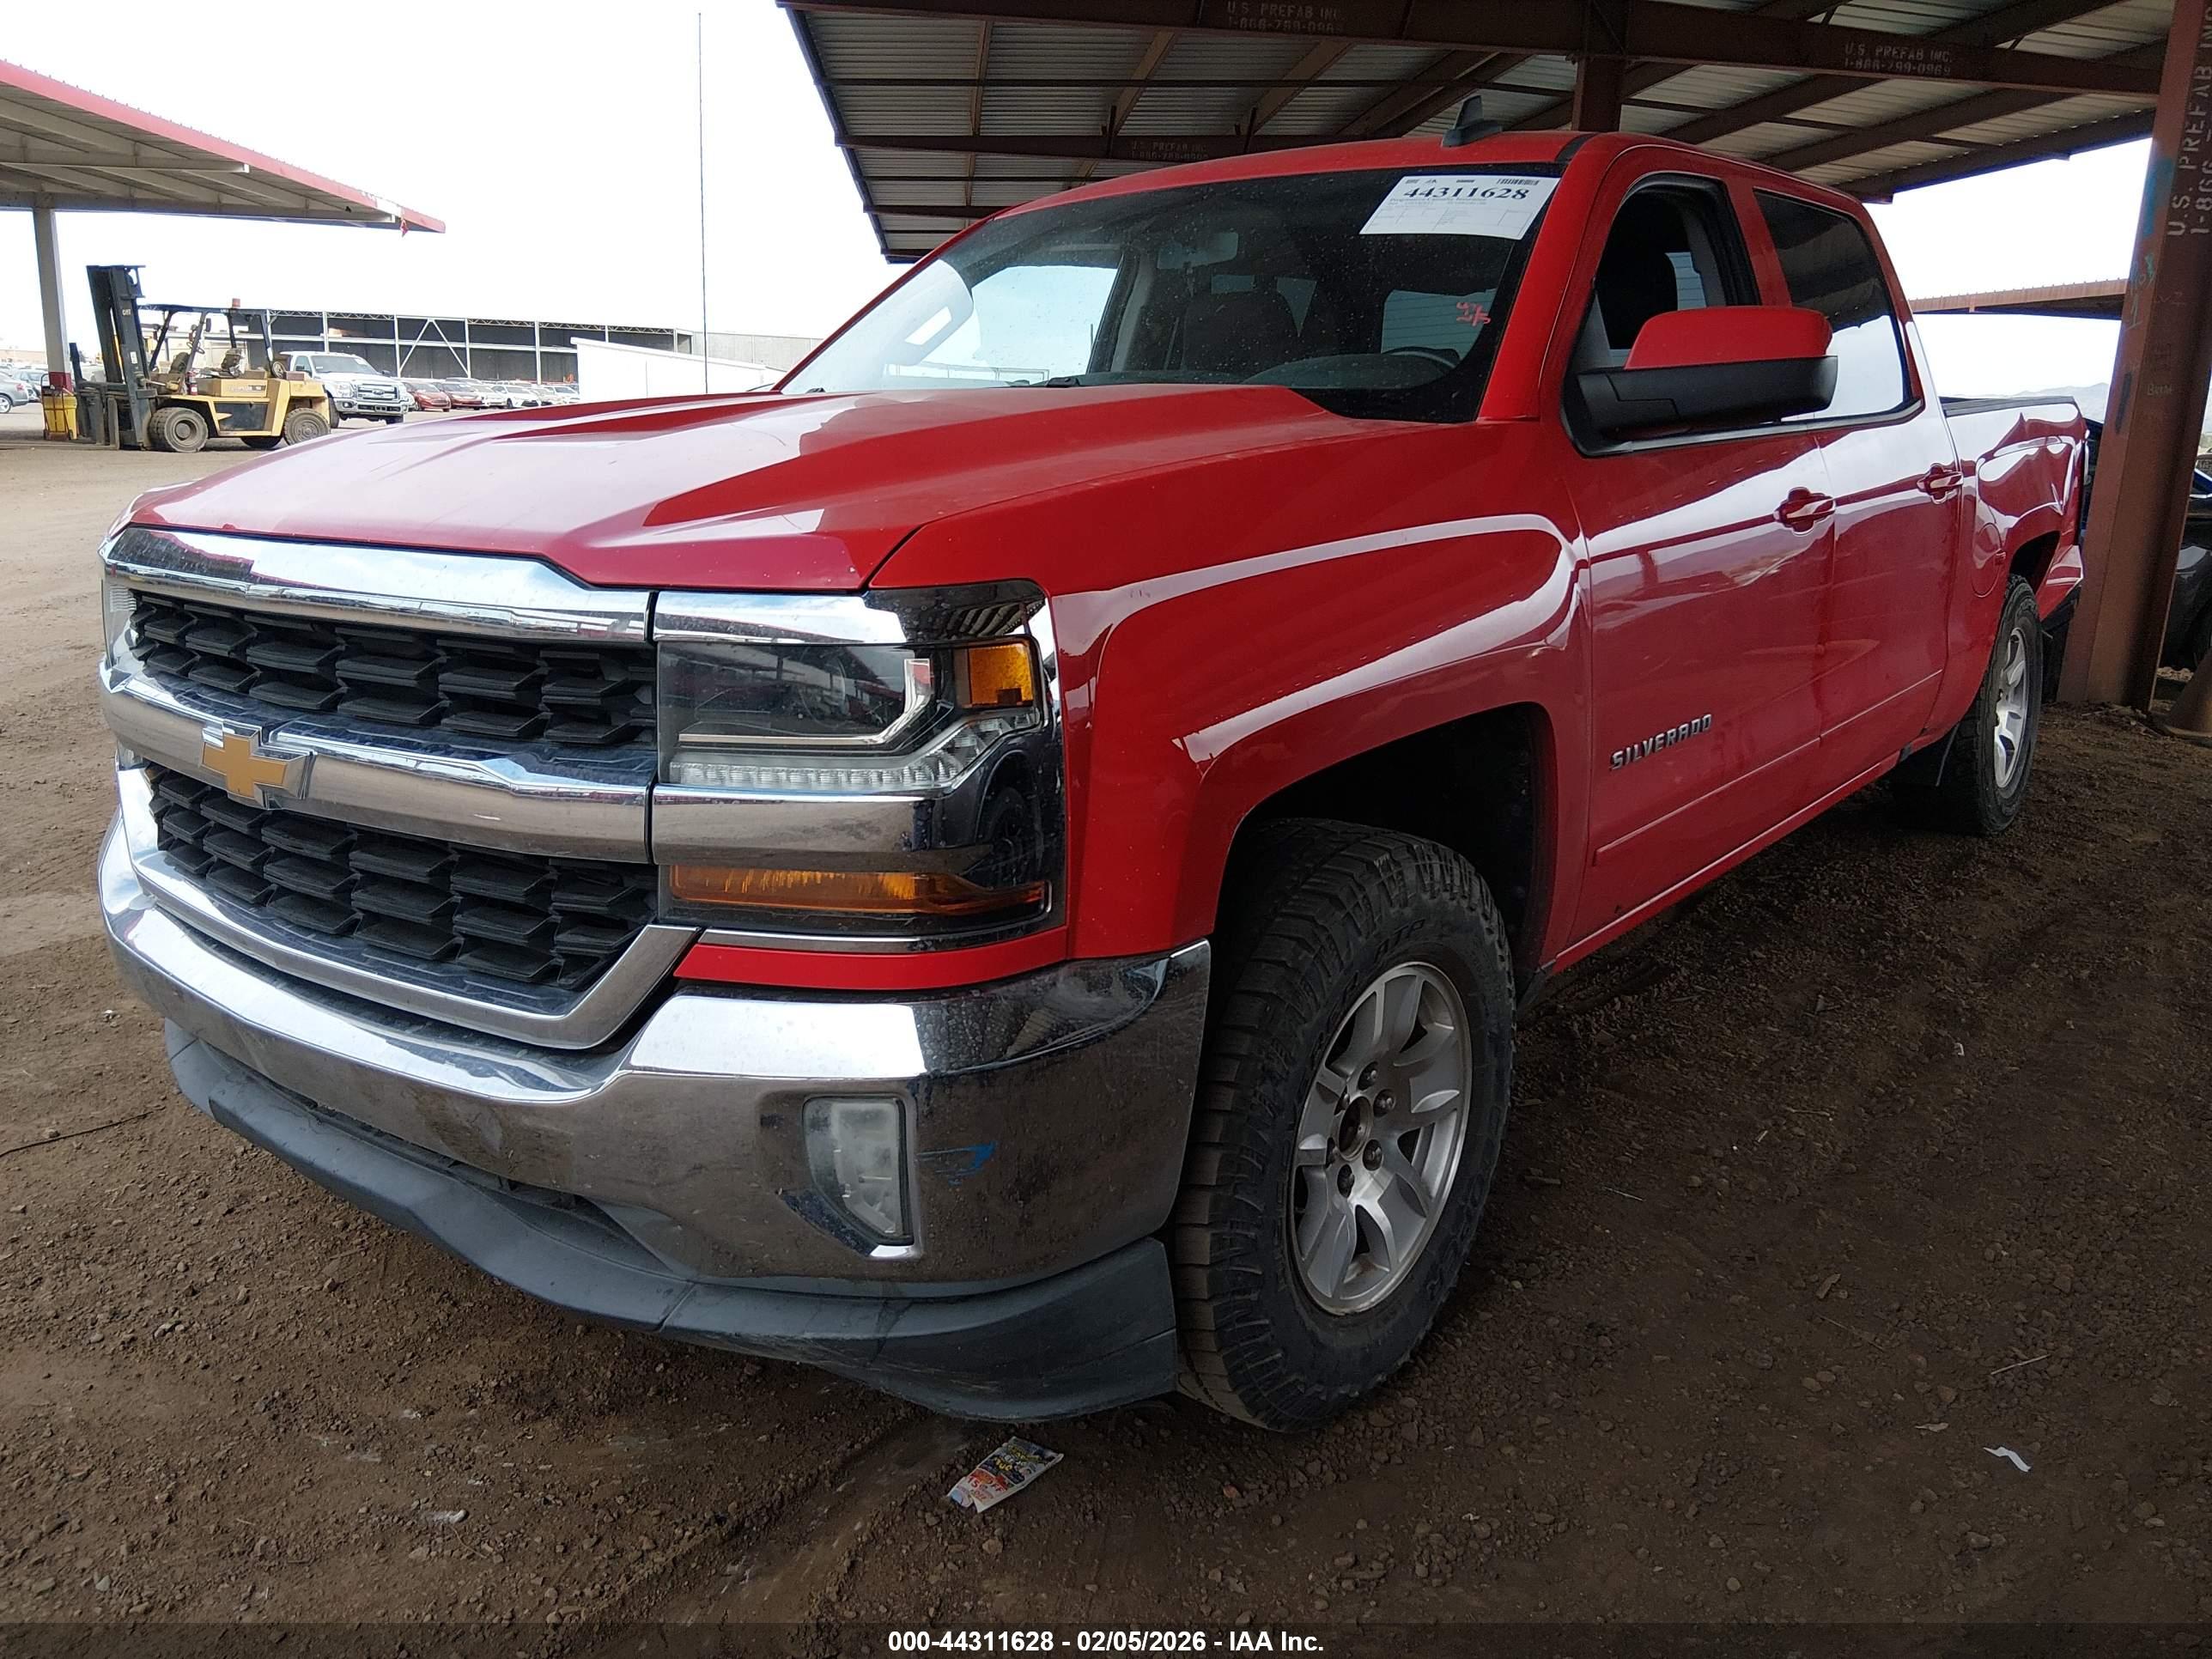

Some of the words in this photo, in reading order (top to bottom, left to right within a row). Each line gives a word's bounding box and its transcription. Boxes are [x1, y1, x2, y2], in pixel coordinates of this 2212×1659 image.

[1875, 46, 1924, 61] PREFAB
[2178, 65, 2212, 169] PREFAB
[1403, 186, 1529, 200] 44311628
[1608, 714, 1712, 770] SILVERADO
